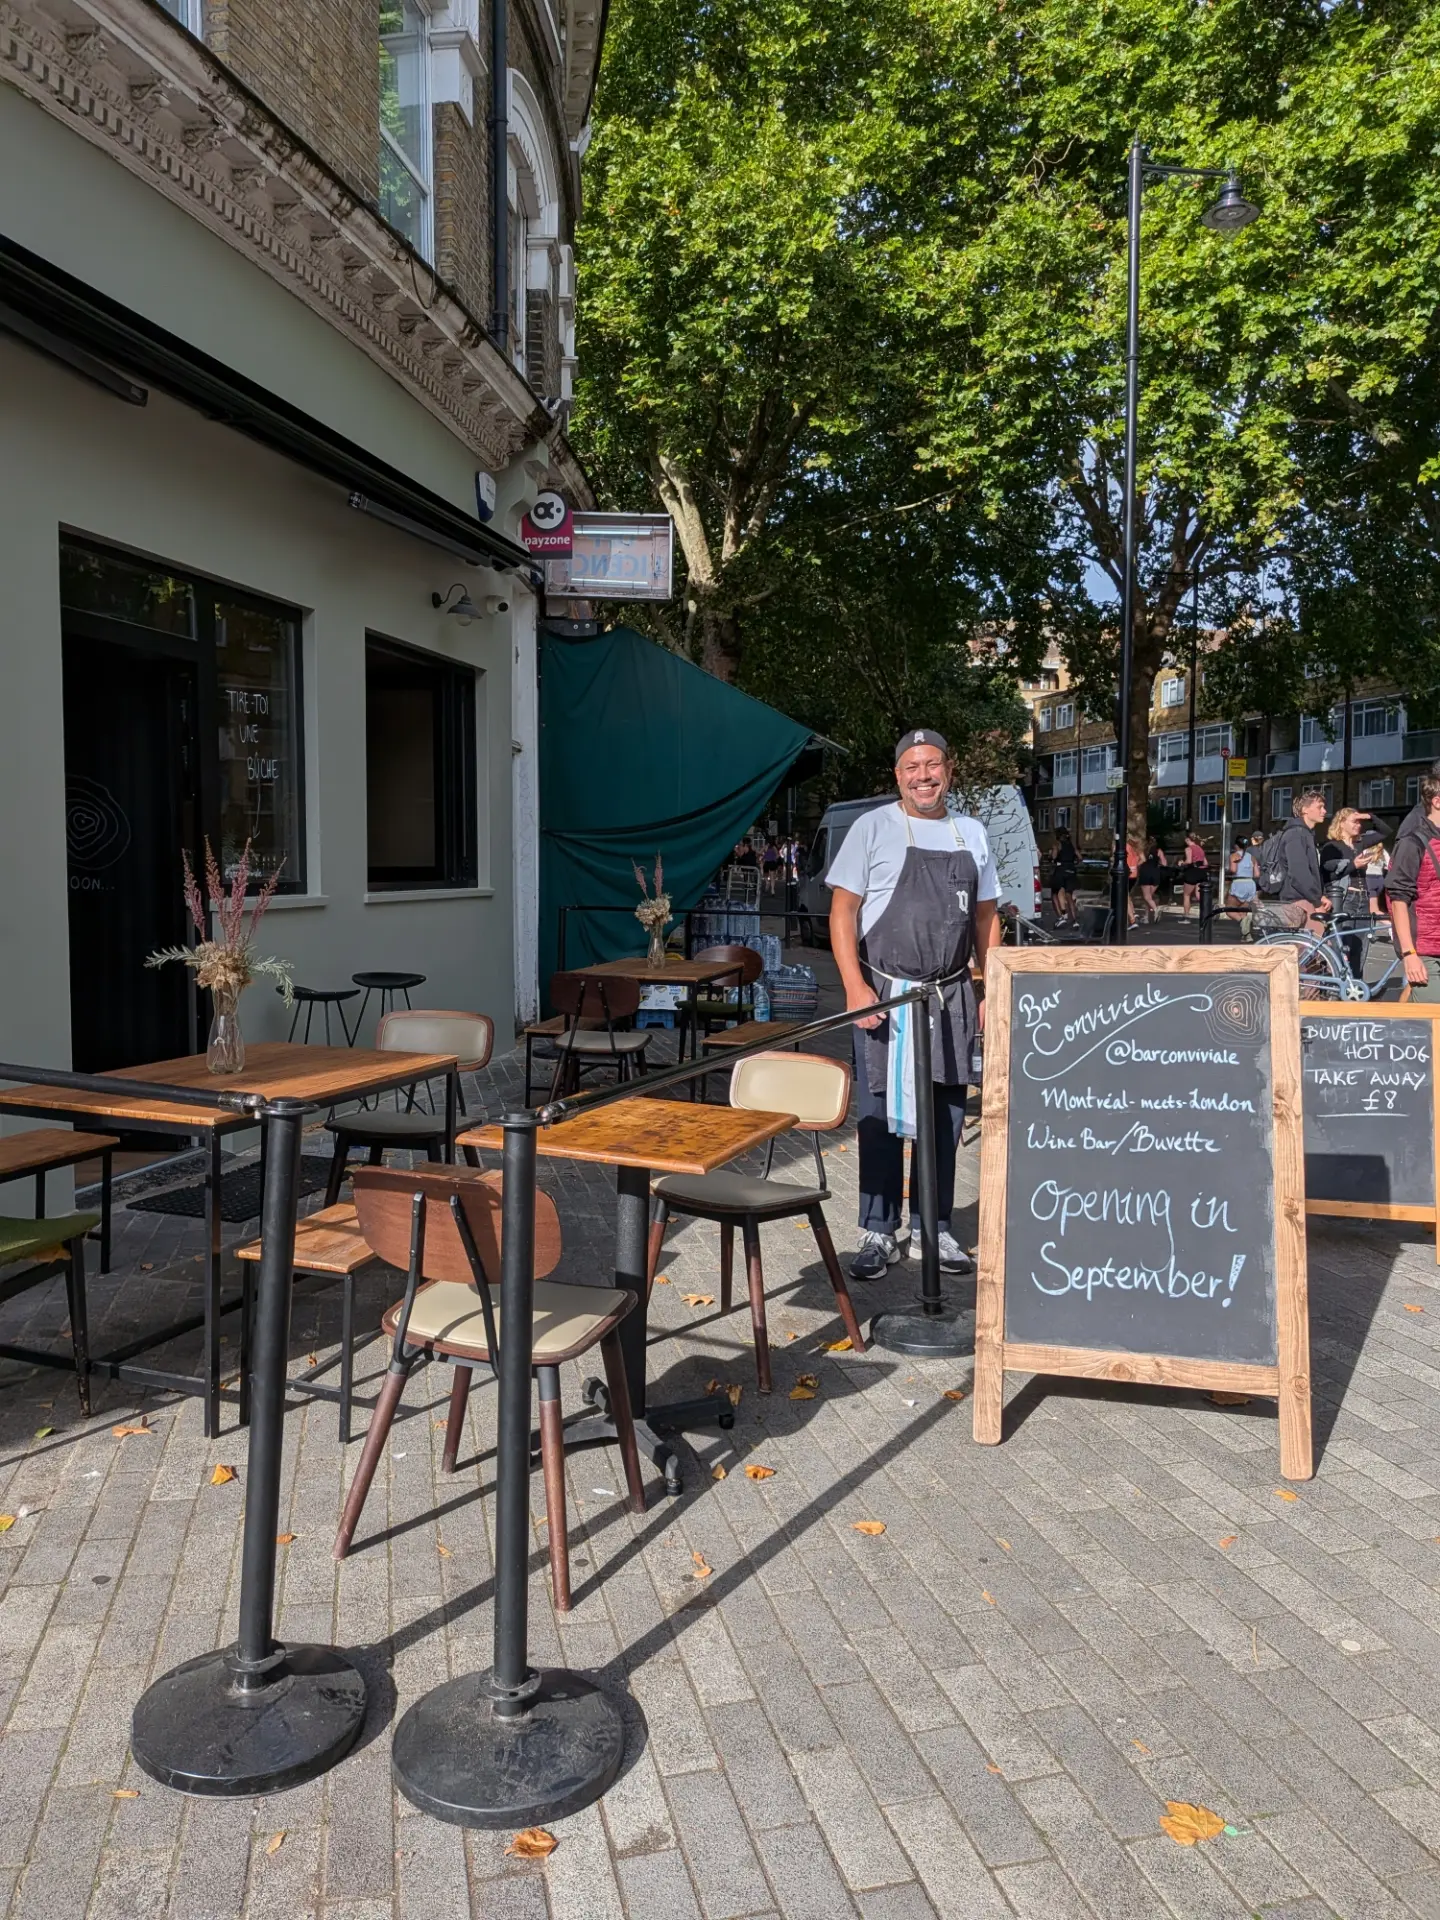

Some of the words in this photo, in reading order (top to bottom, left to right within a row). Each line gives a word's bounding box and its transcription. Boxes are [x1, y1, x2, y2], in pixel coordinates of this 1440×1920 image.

[524, 535, 571, 549] payzone
[225, 689, 269, 715] TIRE-TOI
[238, 723, 259, 743] UNE
[68, 875, 115, 891] OON...
[1018, 989, 1062, 1028] Bar
[1031, 983, 1170, 1056] Conviviale
[1304, 1022, 1387, 1042] BUVETTE
[1105, 1038, 1240, 1065] @barconviviale
[1344, 1043, 1384, 1061] HOT
[1389, 1044, 1431, 1064] DOG
[1304, 1068, 1364, 1086] TAKE
[1369, 1071, 1427, 1091] AWAY
[1360, 1089, 1398, 1111] £8
[1026, 1122, 1077, 1150] Wine
[1030, 1179, 1175, 1273] Opening
[1189, 1191, 1239, 1232] in
[1031, 1241, 1247, 1308] September!
